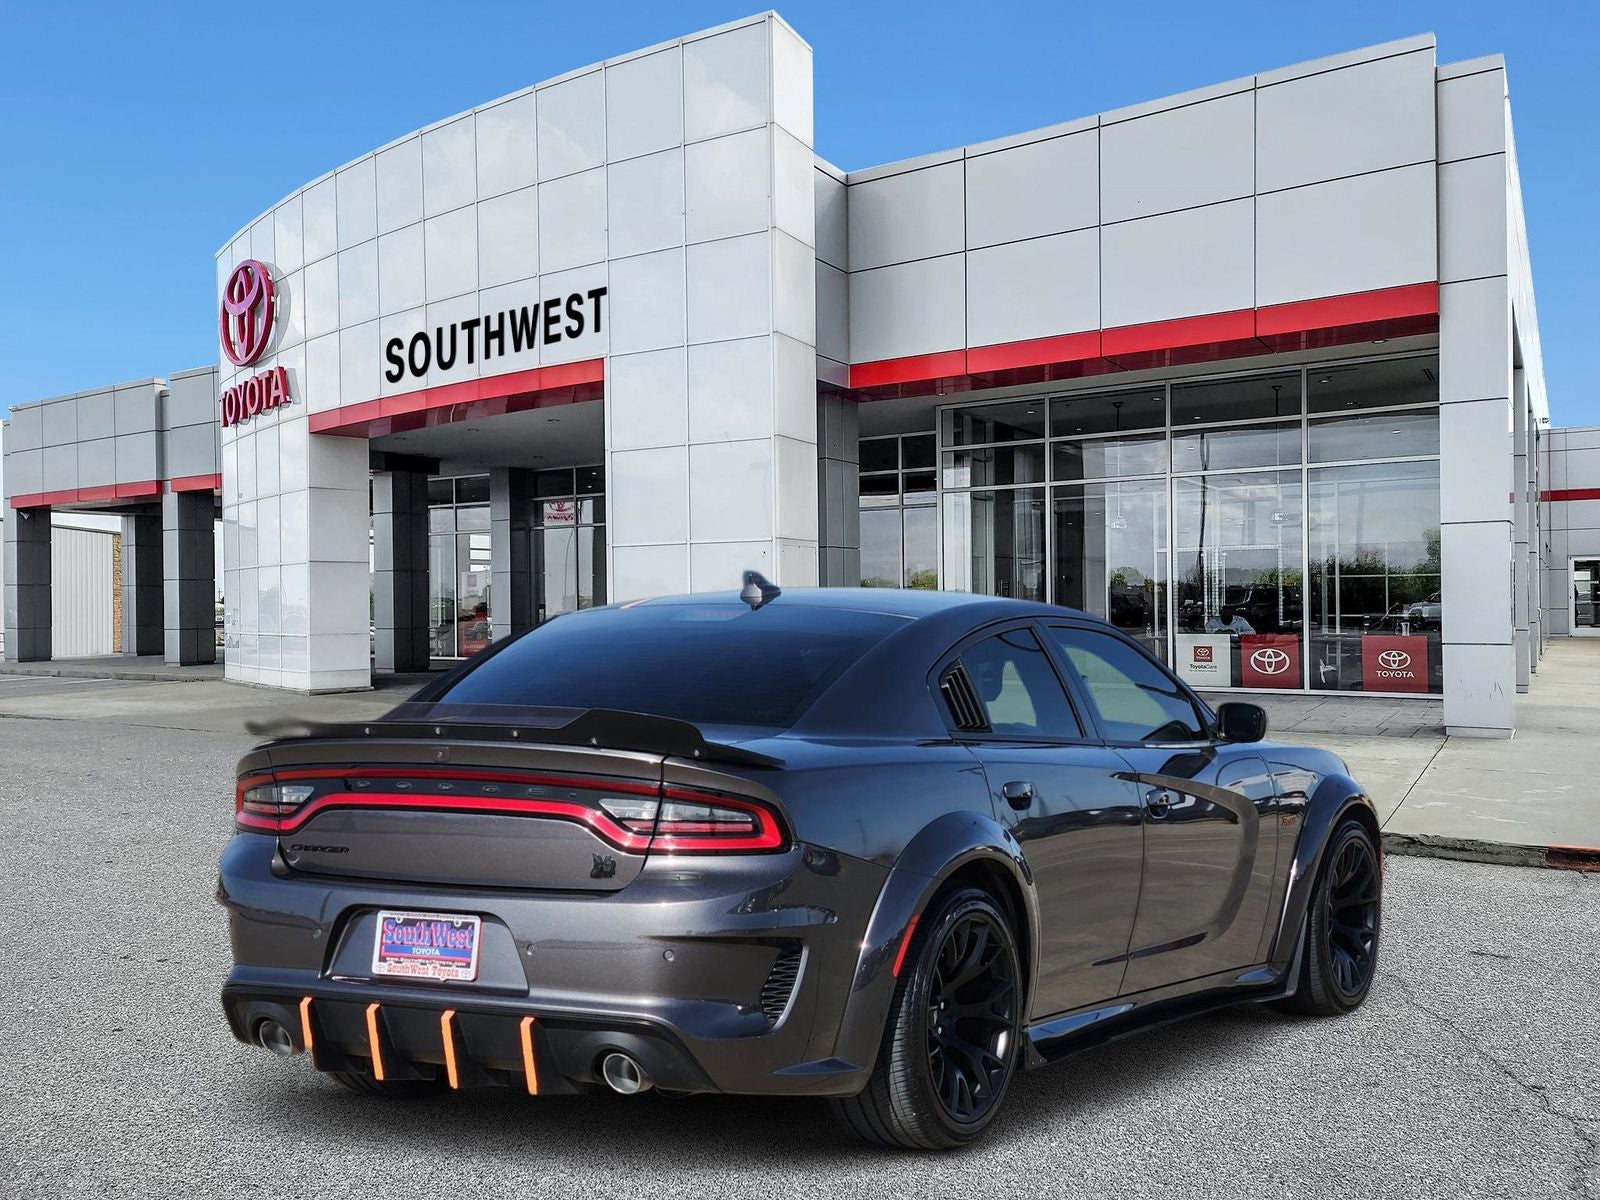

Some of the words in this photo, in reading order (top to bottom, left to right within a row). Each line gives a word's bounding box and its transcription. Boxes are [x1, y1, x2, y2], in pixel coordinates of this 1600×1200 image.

[385, 286, 607, 384] SOUTHWEST
[218, 366, 291, 428] TOYOTA
[1376, 670, 1414, 678] TOYOTA
[291, 844, 350, 854] CHARGER
[412, 947, 440, 955] TOYOTA
[432, 965, 459, 979] Toyota
